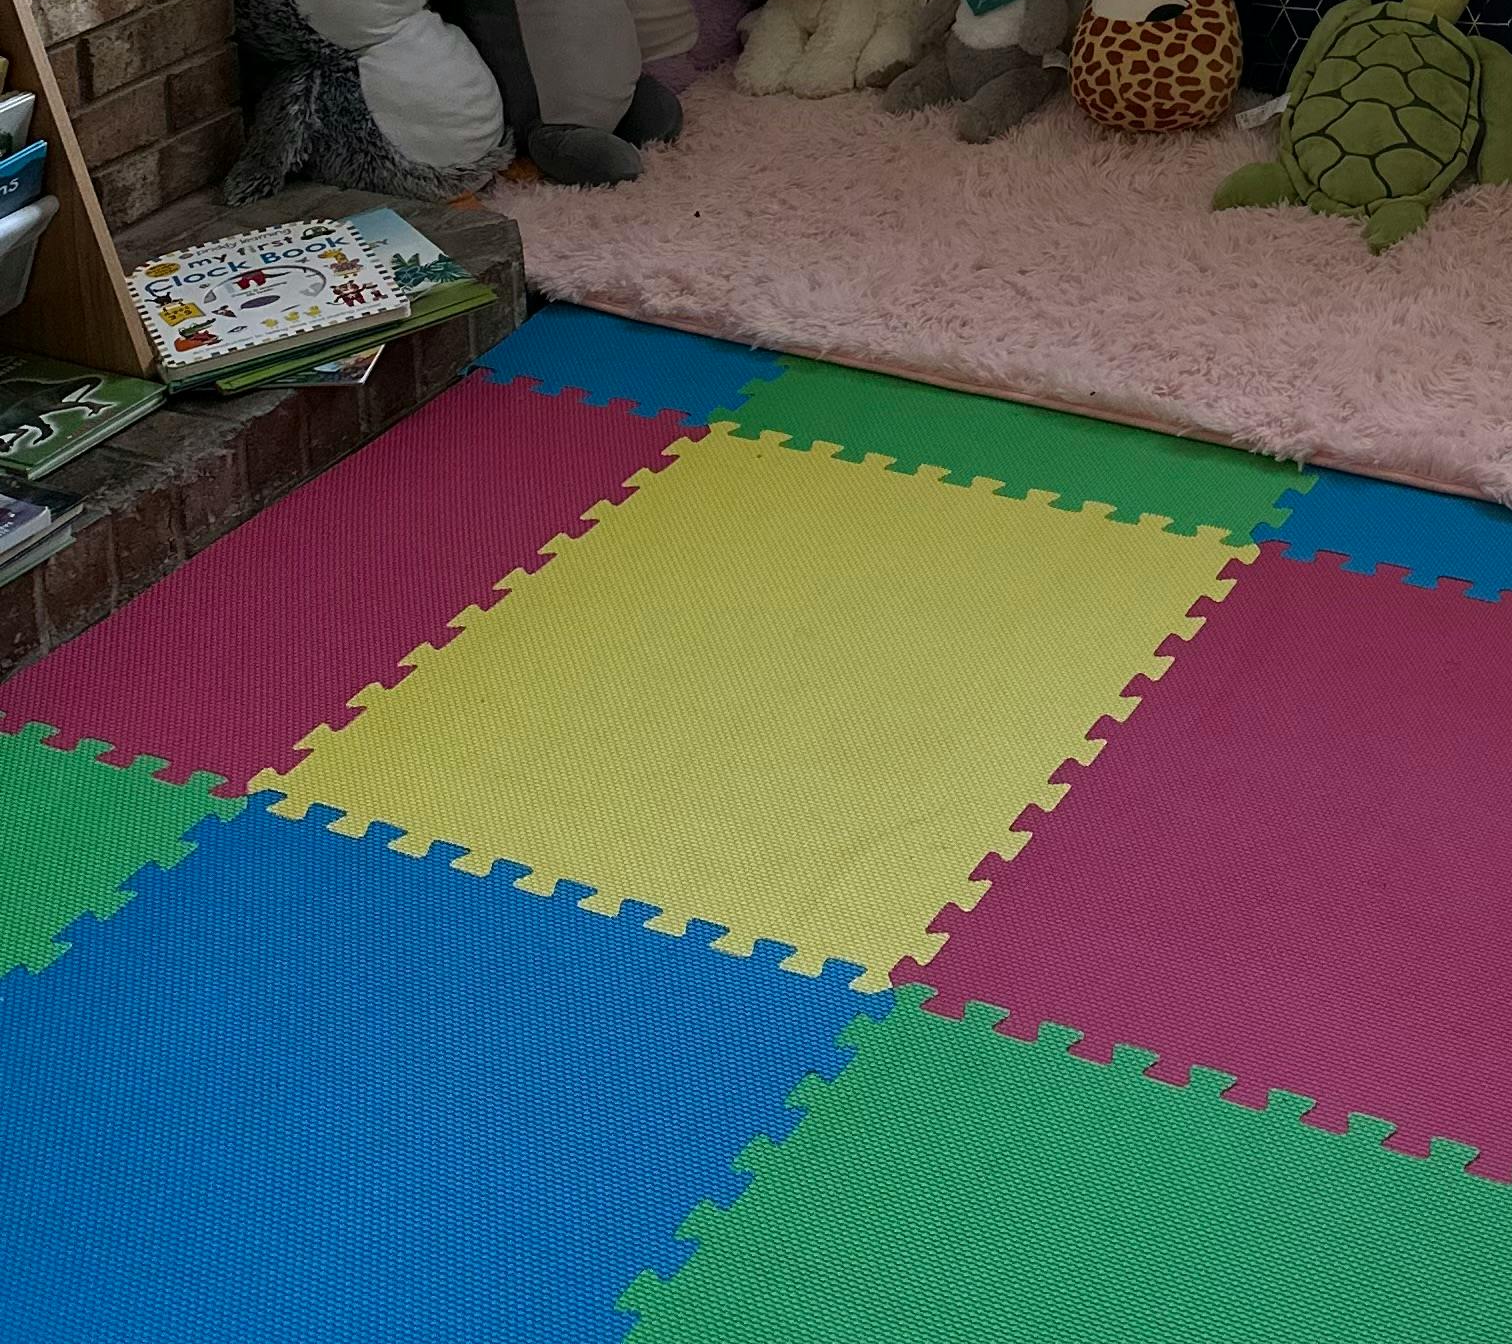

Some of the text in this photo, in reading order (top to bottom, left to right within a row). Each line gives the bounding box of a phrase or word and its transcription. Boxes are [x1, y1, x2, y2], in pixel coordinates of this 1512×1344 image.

[144, 234, 348, 295] Clock Book
[188, 235, 293, 270] my first
